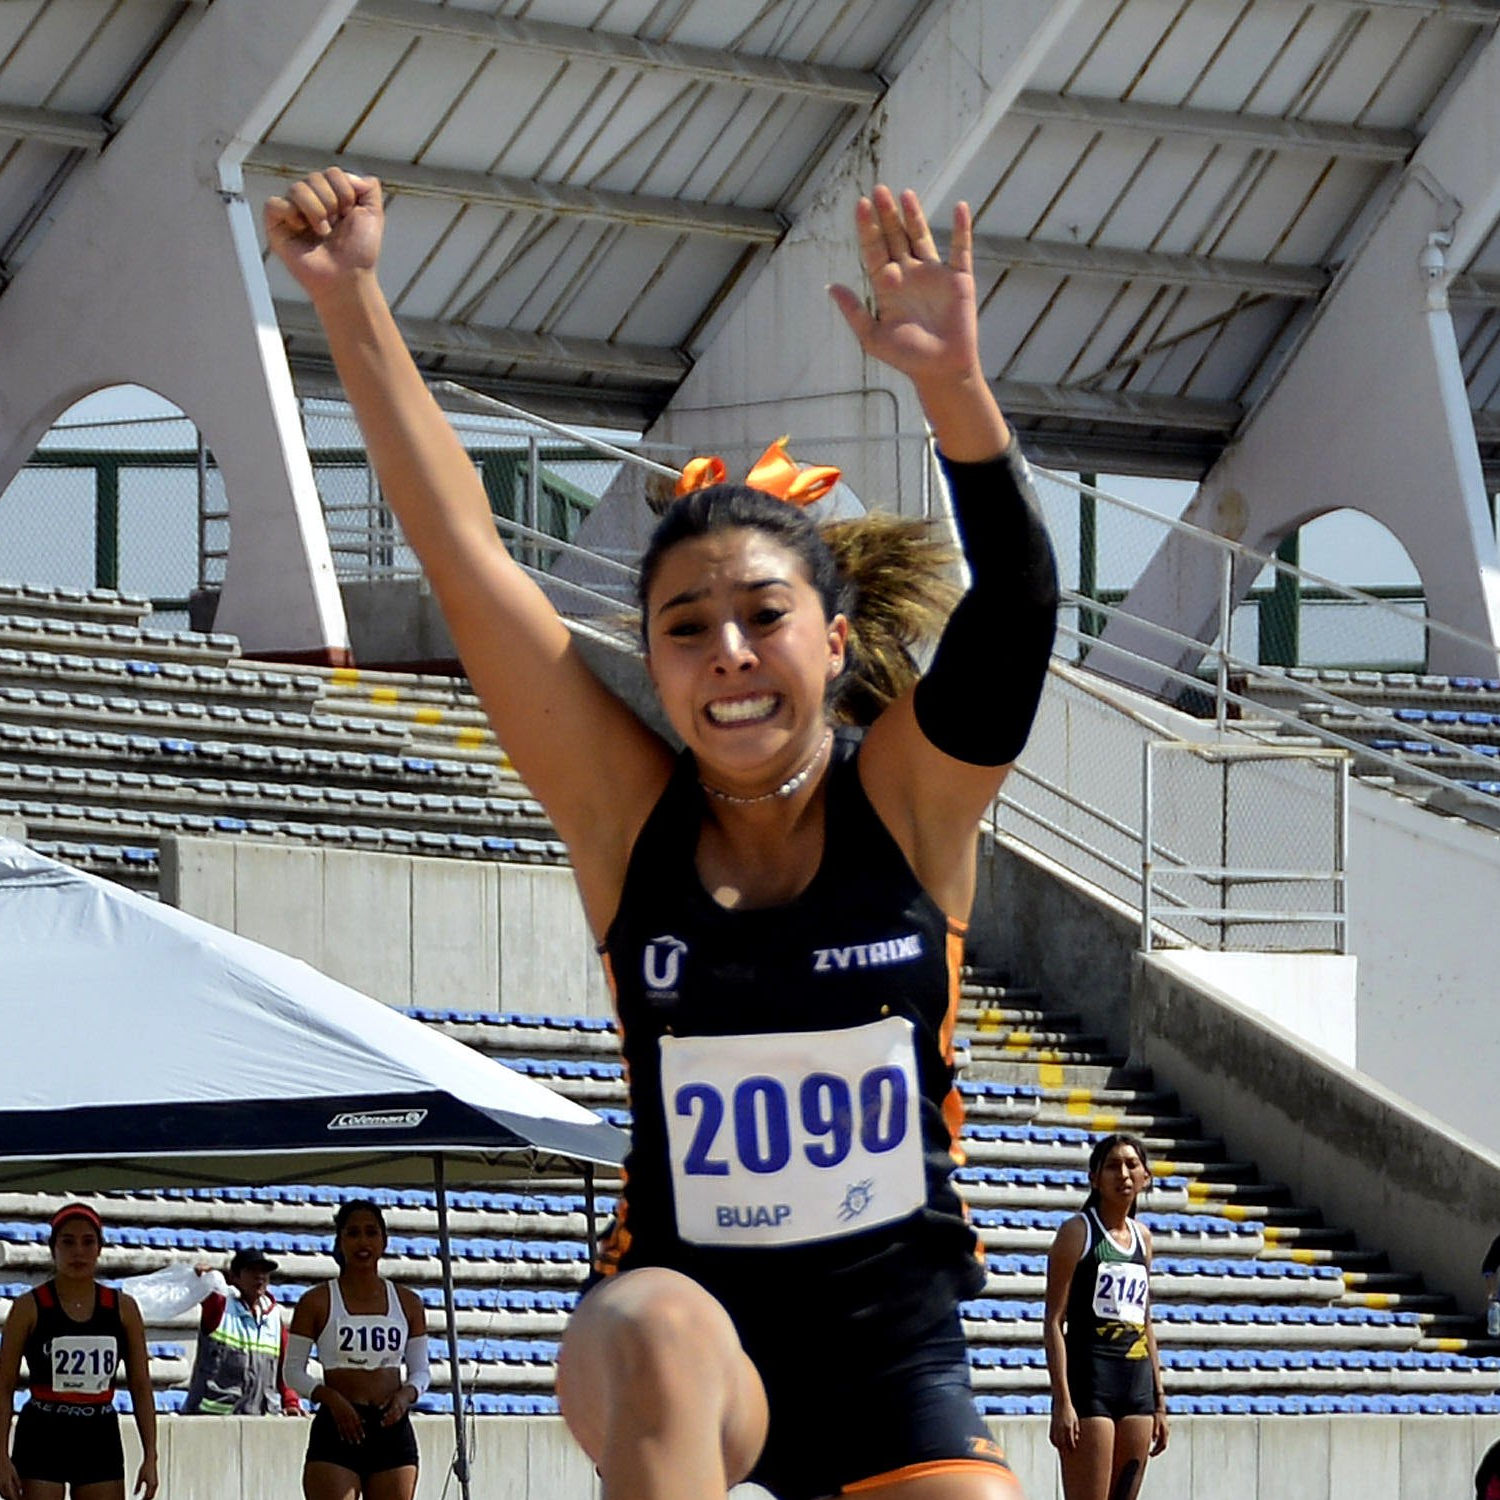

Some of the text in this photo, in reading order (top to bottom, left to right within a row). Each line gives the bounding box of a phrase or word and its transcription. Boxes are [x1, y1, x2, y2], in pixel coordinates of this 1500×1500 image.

[674, 1065, 908, 1176] 2090
[716, 1204, 791, 1228] BUAP
[1097, 1273, 1147, 1306] 2142
[339, 1326, 401, 1352] 2169
[55, 1349, 114, 1375] 2218
